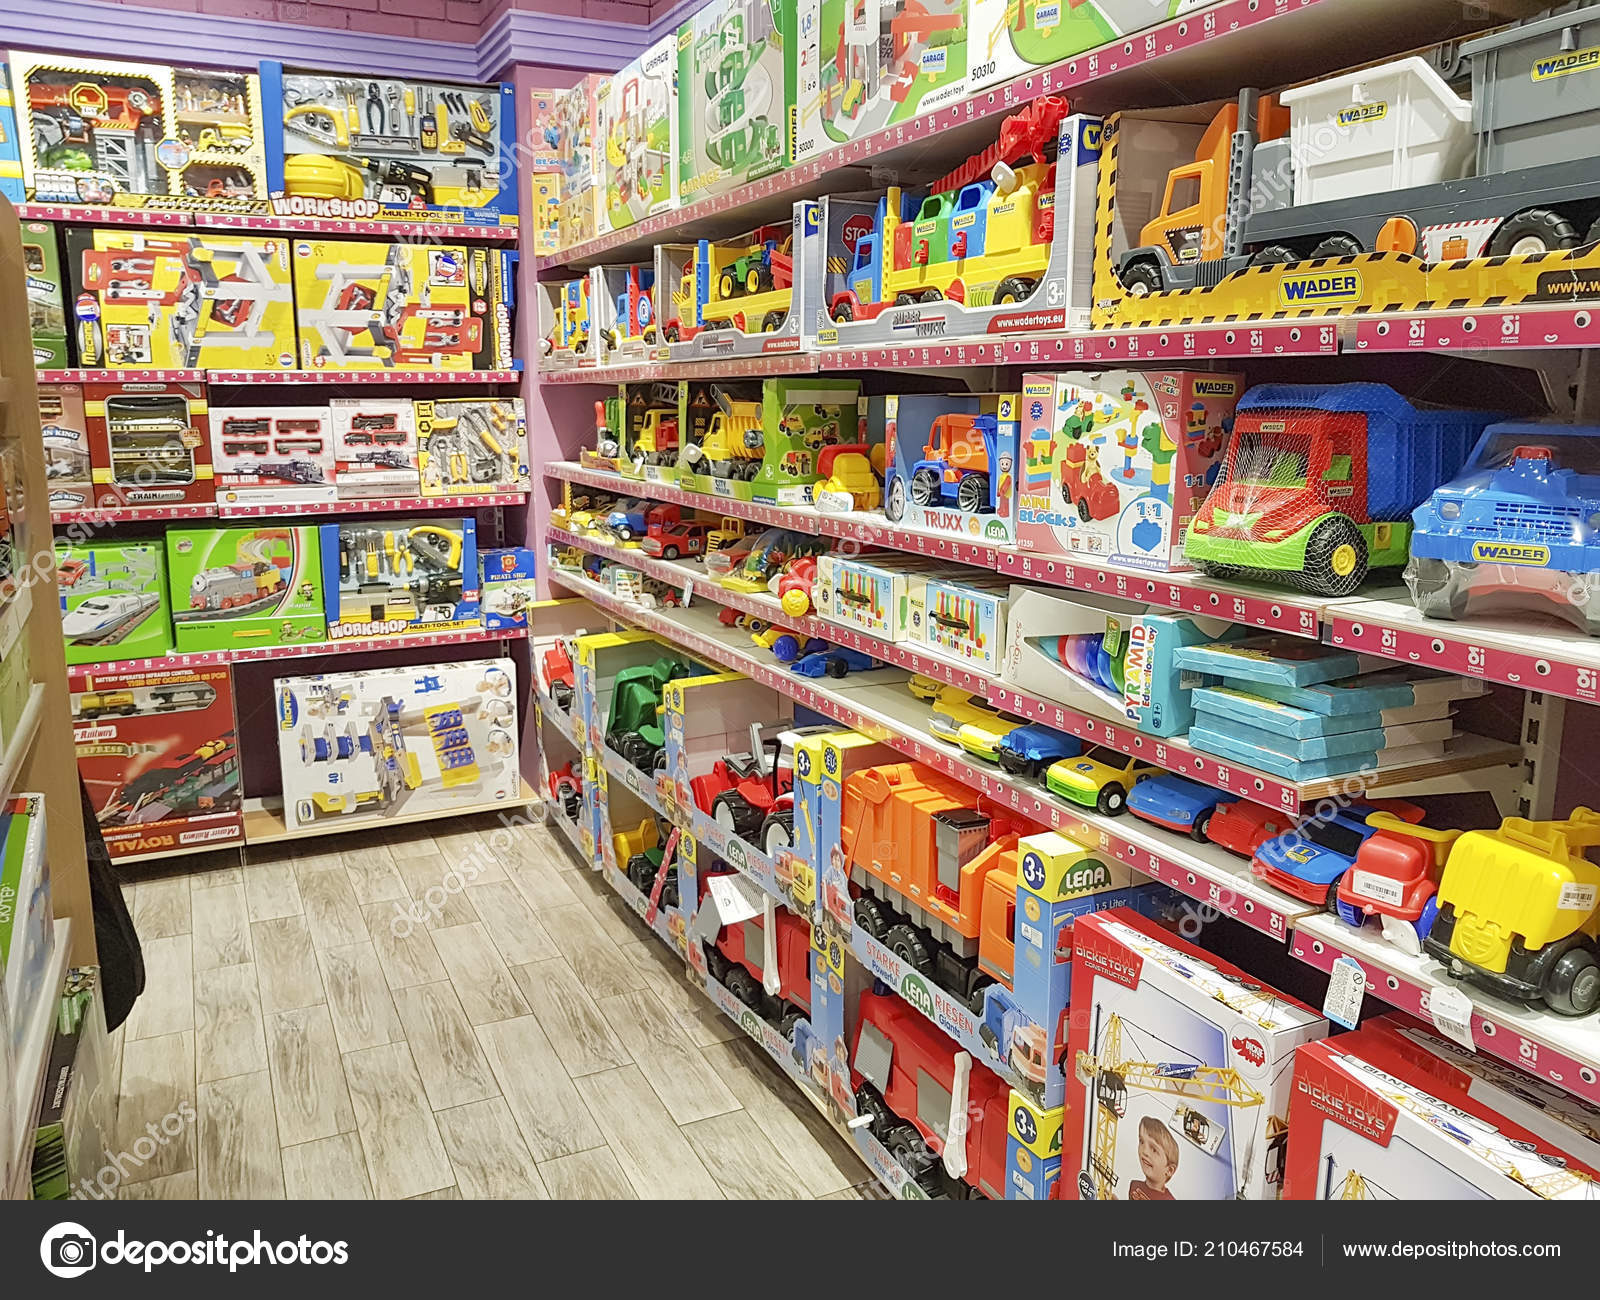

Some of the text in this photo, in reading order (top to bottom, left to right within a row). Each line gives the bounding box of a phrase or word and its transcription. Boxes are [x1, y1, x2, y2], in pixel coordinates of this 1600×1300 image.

[1036, 7, 1058, 20] GARAGE
[922, 53, 945, 65] GARAGE
[971, 61, 996, 81] 50310
[1340, 104, 1385, 123] WADER
[148, 199, 251, 213] Giant Crane Playset
[272, 198, 380, 219] WORKSHOP
[382, 208, 463, 220] MULTI-TOOL SET
[993, 203, 1015, 215] WADER
[916, 223, 935, 234] WADER
[953, 215, 974, 227] WADER
[30, 279, 54, 292] KING
[1048, 282, 1064, 304] 3+
[1284, 276, 1356, 300] WADER
[893, 311, 921, 325] SUPER
[996, 314, 1063, 328] www.wadertoys.eu
[497, 303, 513, 364] WORKSHOP
[818, 330, 838, 342] WADER
[916, 322, 946, 337] TRUCK
[1025, 386, 1051, 395] WADER
[1196, 382, 1234, 394] WADER
[1001, 403, 1011, 415] 2+
[1165, 404, 1177, 416] 3+
[58, 430, 79, 441] KING
[1184, 475, 1204, 487] 1:1
[1137, 502, 1162, 517] 1:1
[923, 510, 963, 532] TRUXX
[1019, 509, 1077, 528] BLOCKS
[988, 526, 1006, 538] LENA
[1478, 545, 1545, 562] WADER
[837, 602, 888, 631] Bowling game
[330, 620, 408, 640] WORKSHOP
[409, 620, 465, 631] MULTI-TOOL SET
[929, 625, 990, 662] Bowling game
[95, 676, 118, 684] BATTERY
[119, 673, 146, 682] OPERATED
[171, 669, 194, 677] CONTROL
[1125, 624, 1147, 722] PYRAMID
[128, 680, 145, 688] THIS
[80, 726, 114, 740] Railway
[798, 752, 811, 771] 3+
[328, 772, 339, 784] 40
[114, 834, 175, 852] ROYAL
[728, 845, 745, 862] LENA
[1024, 856, 1046, 883] 3+
[1066, 865, 1105, 890] LENA
[1110, 898, 1127, 908] Liter
[865, 941, 900, 977] STARKE
[1075, 945, 1136, 979] DICKIE TOYS
[872, 956, 898, 987] Powerful
[1084, 960, 1132, 985] CONSTRUCTION
[906, 981, 932, 1009] LENA
[935, 994, 974, 1034] RIESEN
[938, 1015, 961, 1039] Giants
[1362, 1064, 1476, 1122] GIANT CRANE
[1298, 1080, 1385, 1132] DICKIE TOYS
[1015, 1112, 1036, 1136] 3+
[1310, 1100, 1380, 1139] CONSTRUCTION
